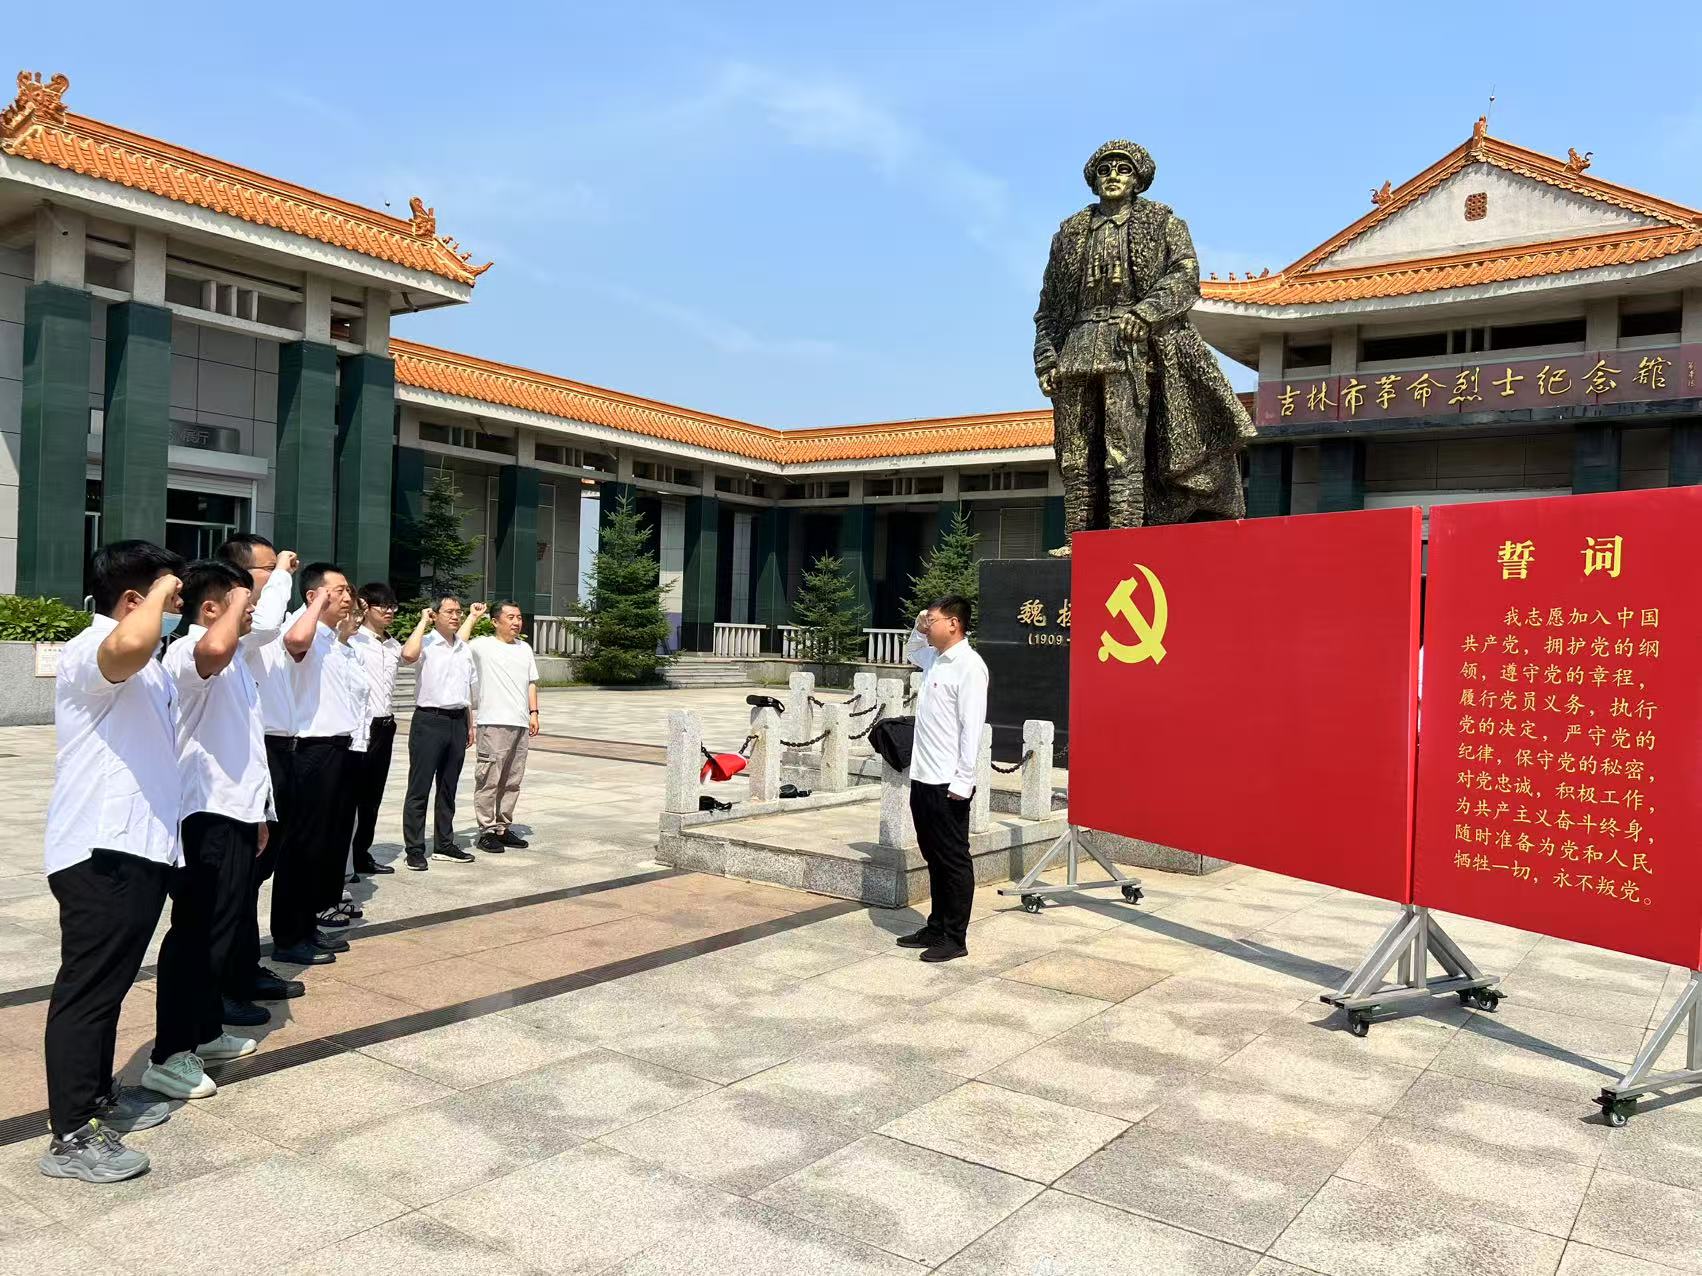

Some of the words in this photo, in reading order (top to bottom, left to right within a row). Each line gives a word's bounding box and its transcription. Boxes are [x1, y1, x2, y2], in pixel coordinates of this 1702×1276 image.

[1496, 534, 1624, 580] 誓词
[1503, 606, 1659, 628] 我志愿加入中国
[1460, 634, 1660, 658] 共产党，拥护党的纲
[1459, 661, 1646, 690] 领，遵守党的章程，
[1459, 688, 1659, 721] 履行党员义务，执行
[1459, 714, 1656, 751] 党的决定，严守党的
[1457, 742, 1656, 783] 纪律，保守党的秘密，
[1456, 769, 1656, 815] 对党忠诚，积极工作，
[1455, 797, 1655, 846] 为共产主义奋斗终身，
[1455, 823, 1653, 875] 随时准备为党和人民
[1453, 849, 1653, 906] 牺牲一切，永不叛党。
